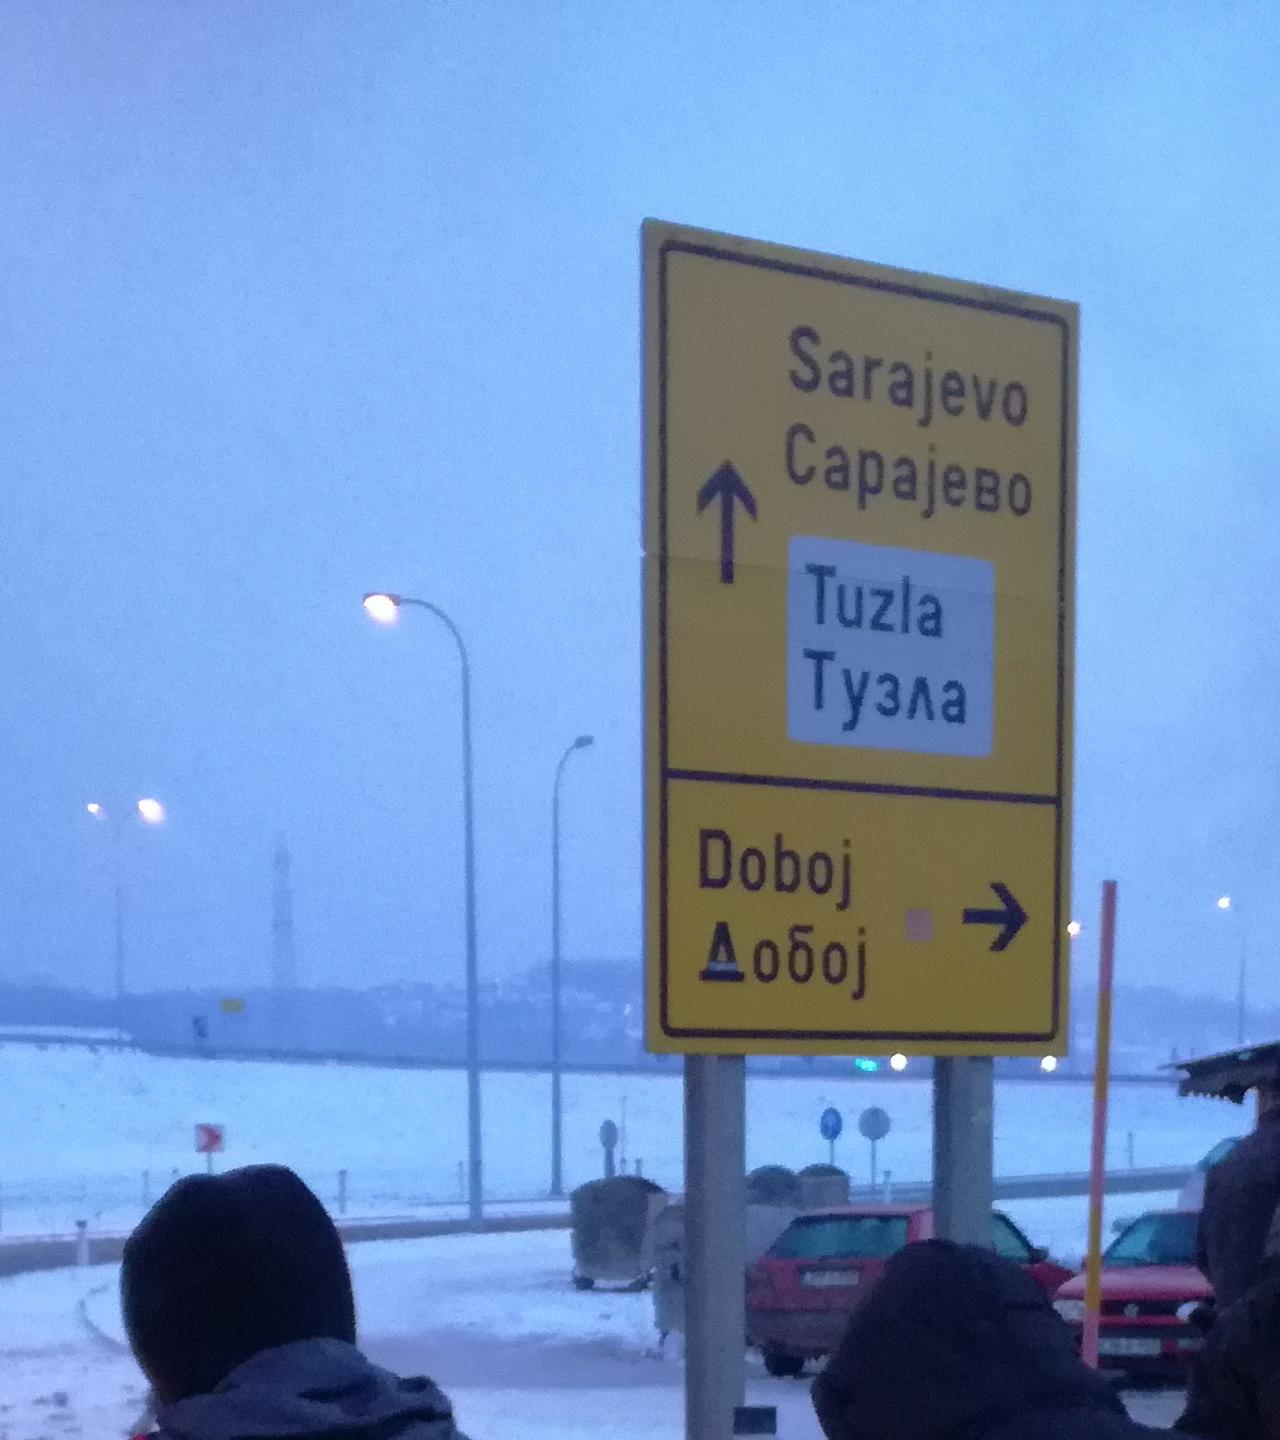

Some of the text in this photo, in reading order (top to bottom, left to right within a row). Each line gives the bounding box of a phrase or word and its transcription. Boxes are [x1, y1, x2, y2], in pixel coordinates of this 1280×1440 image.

[789, 325, 1029, 427] Sarajevo
[785, 422, 1033, 519] Сарајево
[805, 564, 943, 638] Tuzla
[803, 648, 967, 732] Тузла
[698, 828, 853, 912] Doboj
[699, 920, 867, 999] Добој
